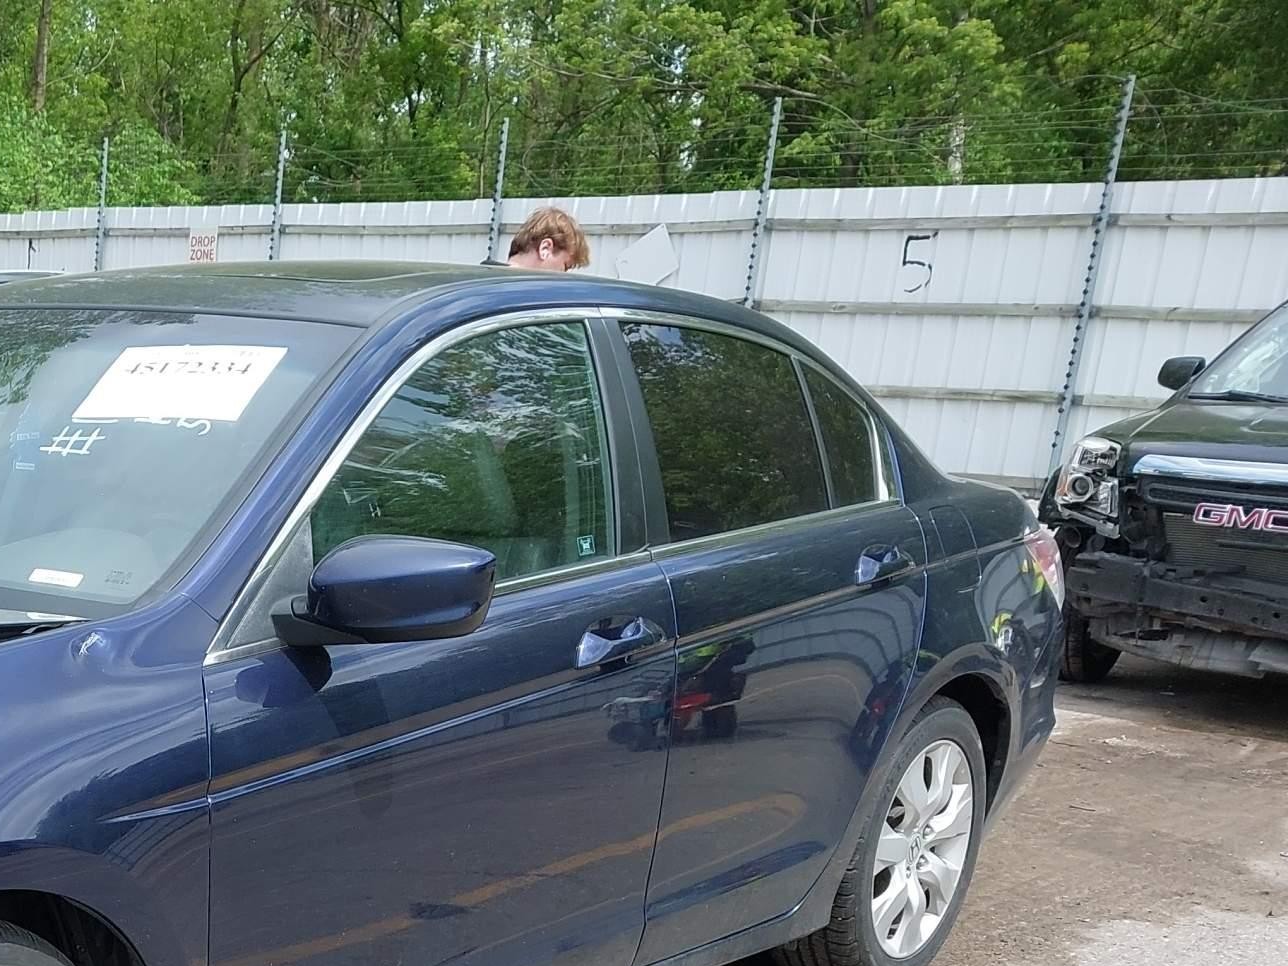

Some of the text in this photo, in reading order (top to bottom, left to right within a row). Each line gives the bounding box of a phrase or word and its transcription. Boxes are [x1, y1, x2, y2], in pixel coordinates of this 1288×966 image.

[190, 235, 216, 248] DROP
[190, 249, 215, 261] ZONE
[902, 229, 939, 294] 5
[125, 361, 253, 376] 45172334
[1193, 502, 1288, 534] GMC
